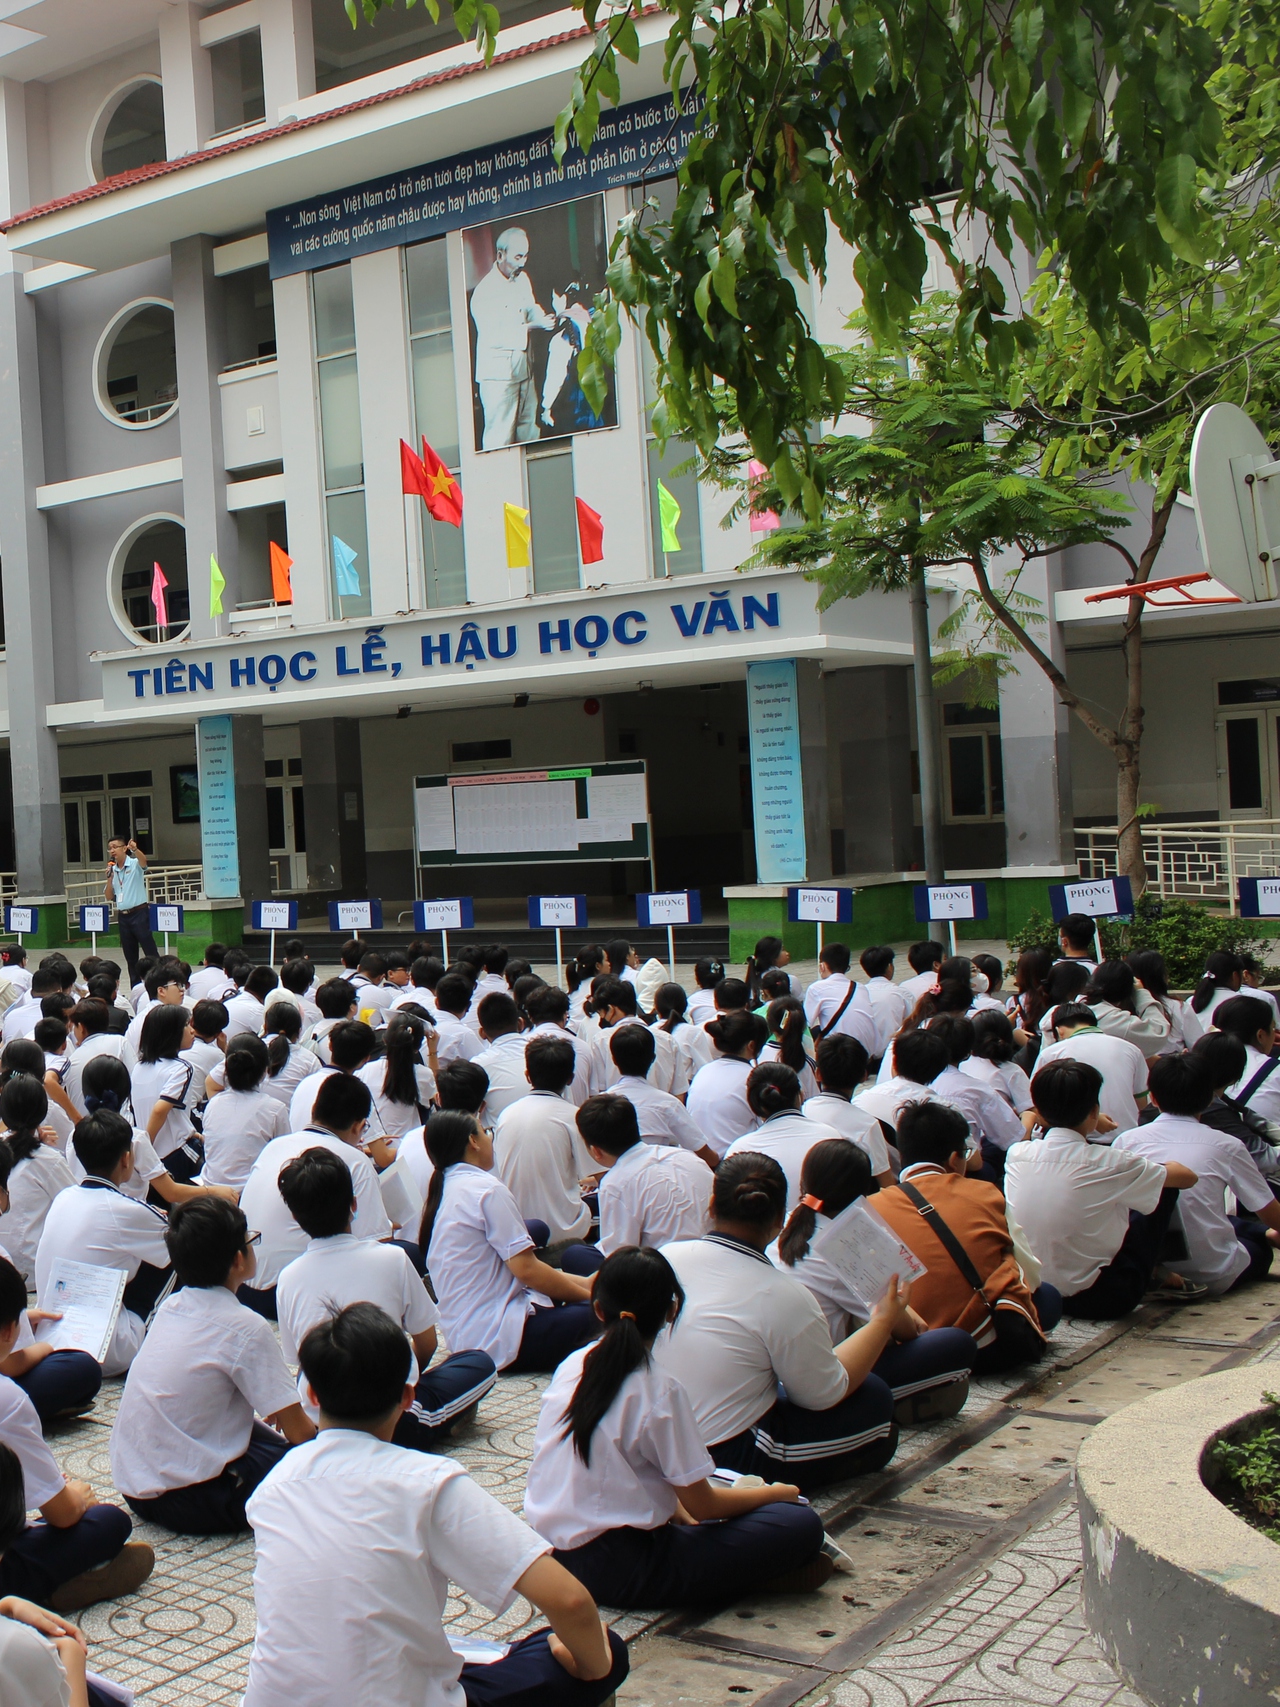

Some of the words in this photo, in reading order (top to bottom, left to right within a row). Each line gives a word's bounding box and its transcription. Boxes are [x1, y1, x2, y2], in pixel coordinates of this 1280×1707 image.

[318, 204, 341, 221] sông
[343, 194, 361, 216] Việt
[363, 191, 383, 210] Nam
[385, 182, 397, 202] có
[399, 176, 413, 198] trở
[415, 174, 433, 193] nên
[434, 169, 452, 188] tươi
[454, 164, 473, 186] đẹp
[475, 158, 492, 177] hay
[494, 149, 528, 171] không,
[619, 114, 632, 135] có
[634, 107, 661, 131] bước
[606, 174, 626, 185] Trích
[290, 238, 303, 256] vai
[304, 234, 320, 253] các
[351, 216, 375, 243] quốc
[376, 213, 396, 232] năm
[397, 206, 421, 227] châu
[422, 200, 446, 221] được
[447, 195, 465, 214] hay
[467, 186, 501, 208] không,
[502, 175, 531, 198] chính
[532, 169, 543, 190] là
[566, 157, 588, 180] một
[590, 147, 617, 178] phần
[619, 144, 637, 165] lớn
[639, 138, 648, 159] ở
[649, 134, 677, 156] công
[127, 658, 214, 698] TIÊN
[229, 650, 318, 692] HỌC
[335, 626, 404, 678] LỄ,
[421, 622, 518, 670] HẬU
[538, 610, 648, 658] HỌC
[670, 590, 781, 638] VĂN
[933, 890, 969, 901] PHÒNG
[1070, 885, 1110, 899] PHÒNG
[653, 898, 684, 907] PHÒNG
[802, 894, 834, 904] PHÒNG
[543, 901, 573, 910] PHÒNG
[948, 903, 954, 912] 5
[1089, 900, 1095, 908] 4
[159, 909, 176, 918] PHÒNG
[264, 905, 287, 914] PHÒNG
[341, 905, 368, 914] PHÒNG
[427, 904, 457, 914] PHÒNG
[666, 909, 671, 917] 7
[12, 911, 30, 919] PHÒNG
[87, 910, 102, 918] PHÒNG
